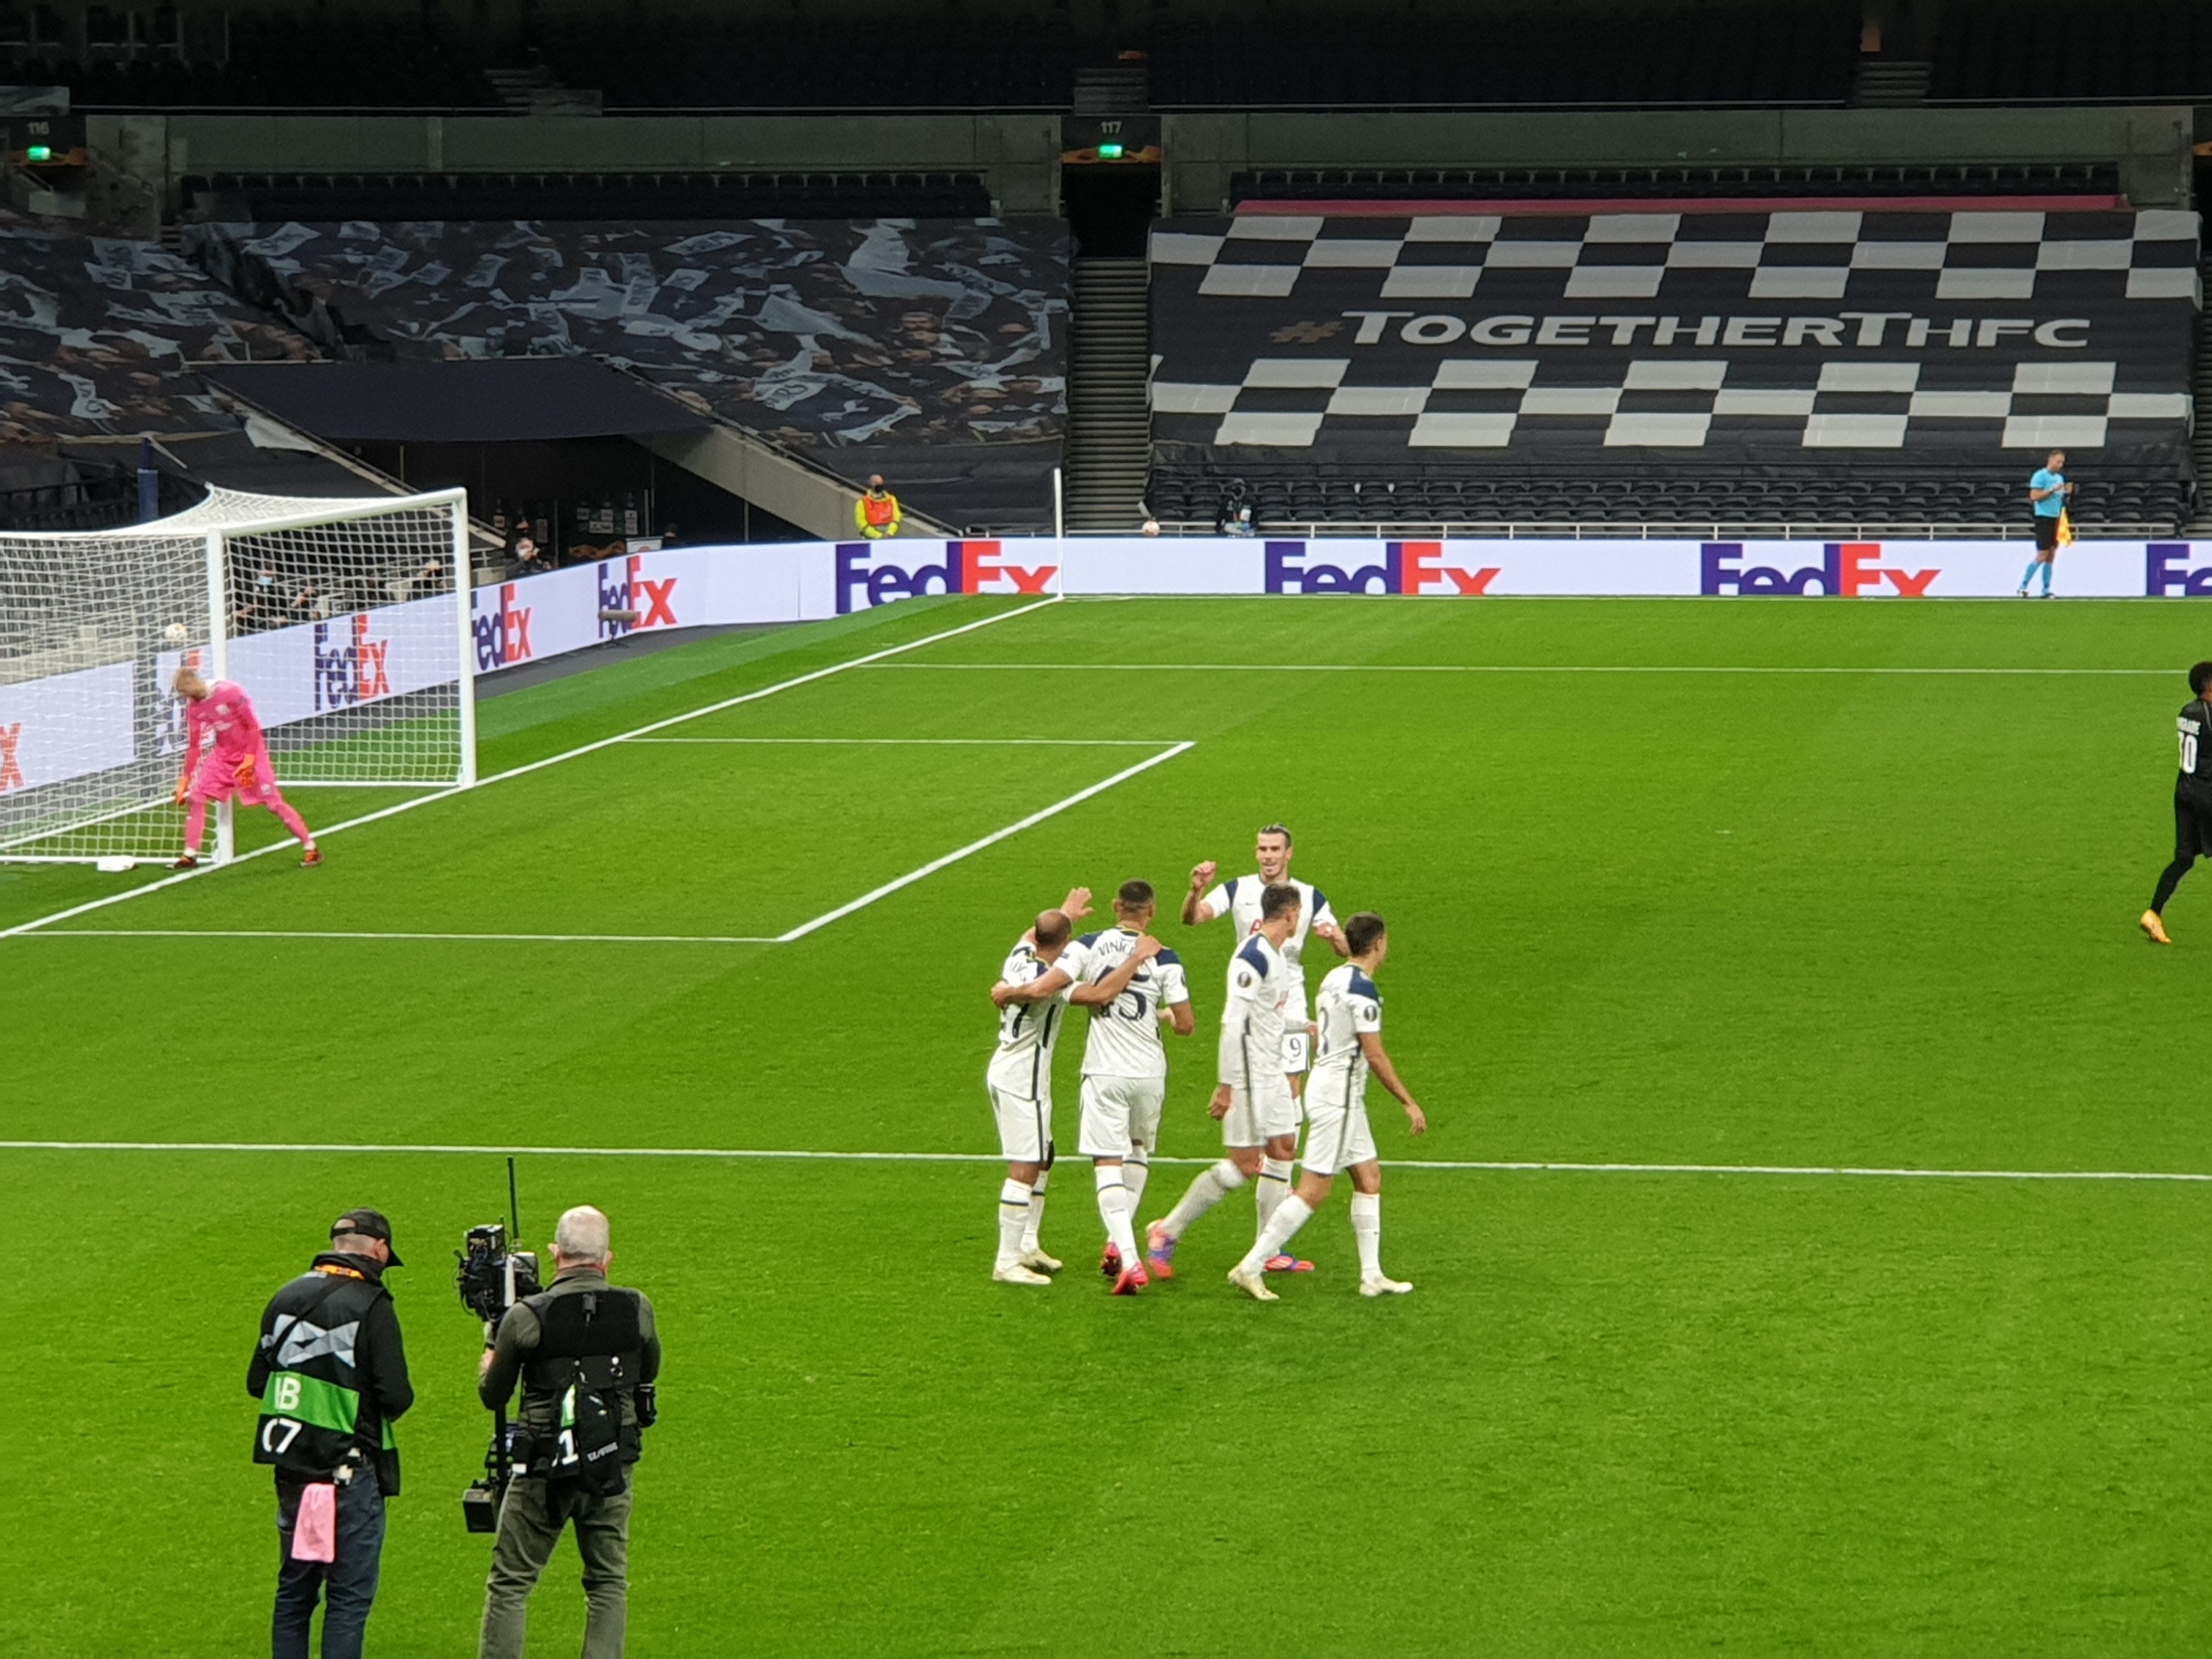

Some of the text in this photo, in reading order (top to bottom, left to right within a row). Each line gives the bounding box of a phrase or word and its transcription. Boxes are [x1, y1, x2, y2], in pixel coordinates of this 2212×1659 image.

[1101, 121, 1122, 133] 117
[836, 540, 1058, 614] FedEx
[1265, 541, 1502, 595] FedEx
[1701, 543, 1942, 597] FedEx
[598, 555, 678, 638] FedEx
[314, 614, 391, 712] FedEx
[1289, 1037, 1301, 1058] 9
[552, 1429, 579, 1467] 1
